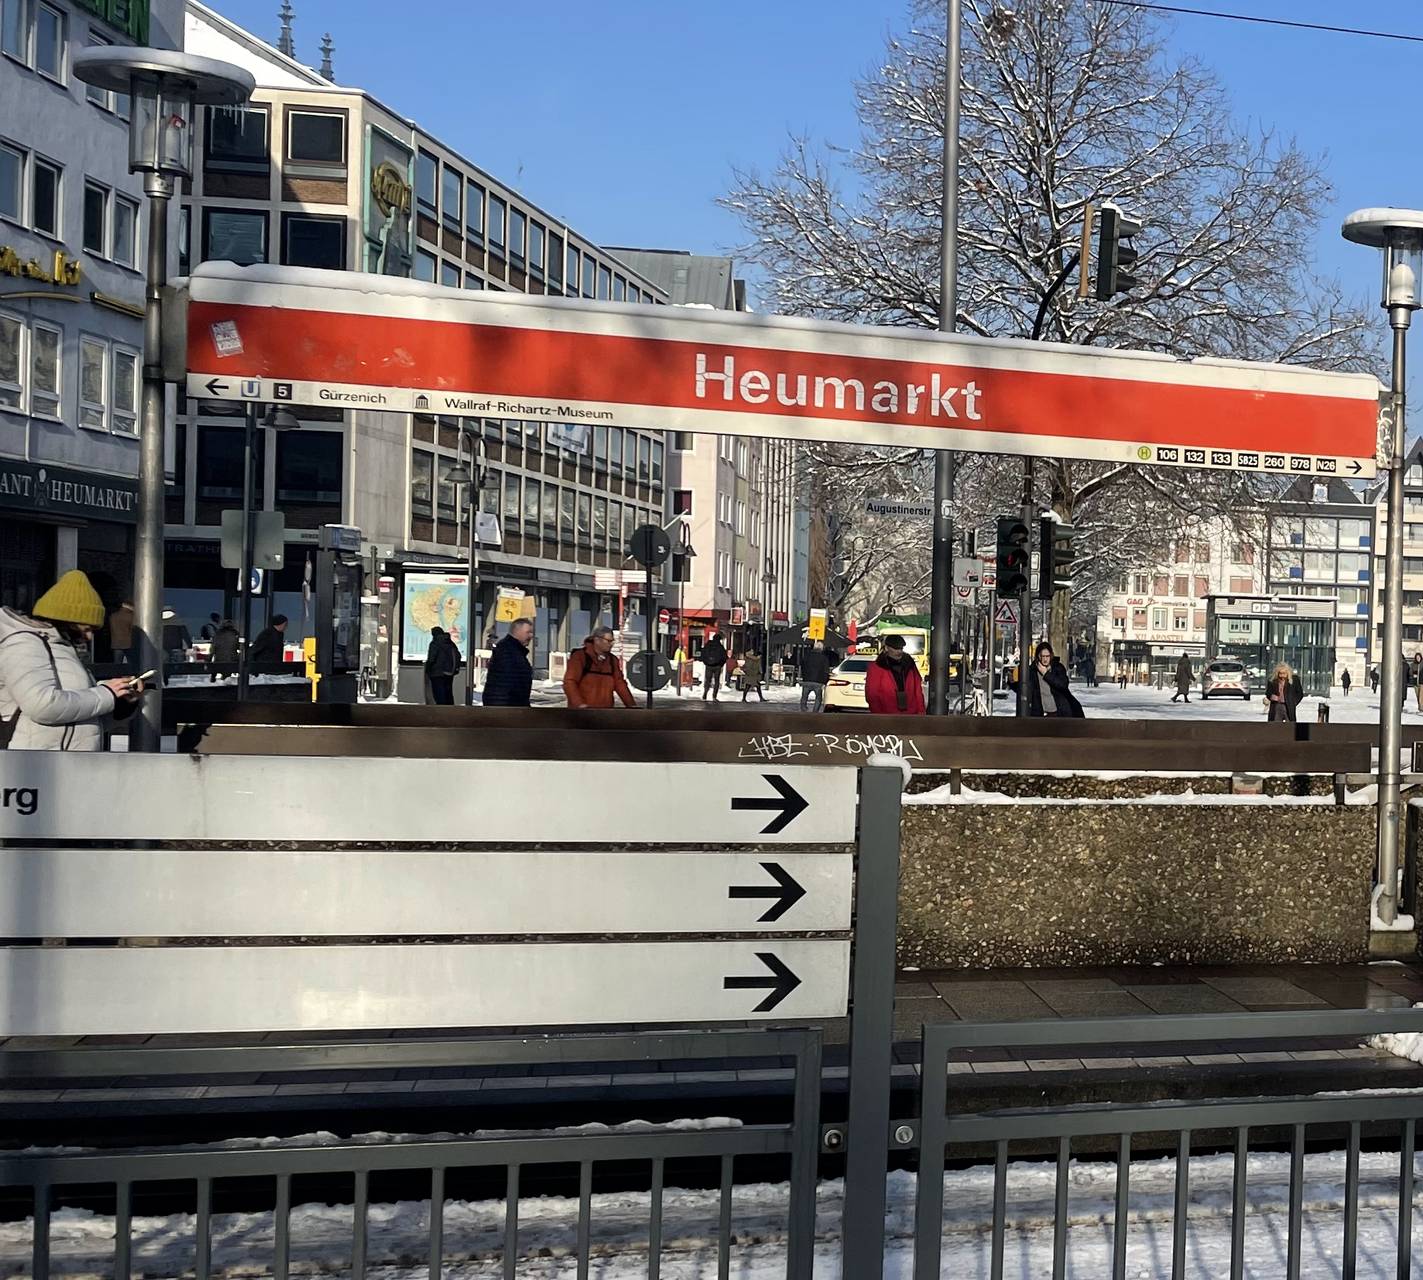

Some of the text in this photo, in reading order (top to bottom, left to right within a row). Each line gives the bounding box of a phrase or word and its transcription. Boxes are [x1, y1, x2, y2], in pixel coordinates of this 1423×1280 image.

[242, 381, 387, 405] U 5 Gürzenich
[695, 352, 982, 421] Heumarkt
[444, 397, 614, 420] Wallraf-Richartz-Museum
[1158, 449, 1177, 461] 106
[1185, 451, 1204, 463] 132
[1212, 453, 1231, 465] 133
[1238, 454, 1258, 467] SB25
[1265, 456, 1284, 468] 260
[1291, 457, 1310, 470] 978
[1316, 459, 1336, 472] N26
[51, 480, 134, 511] HEUMARKT
